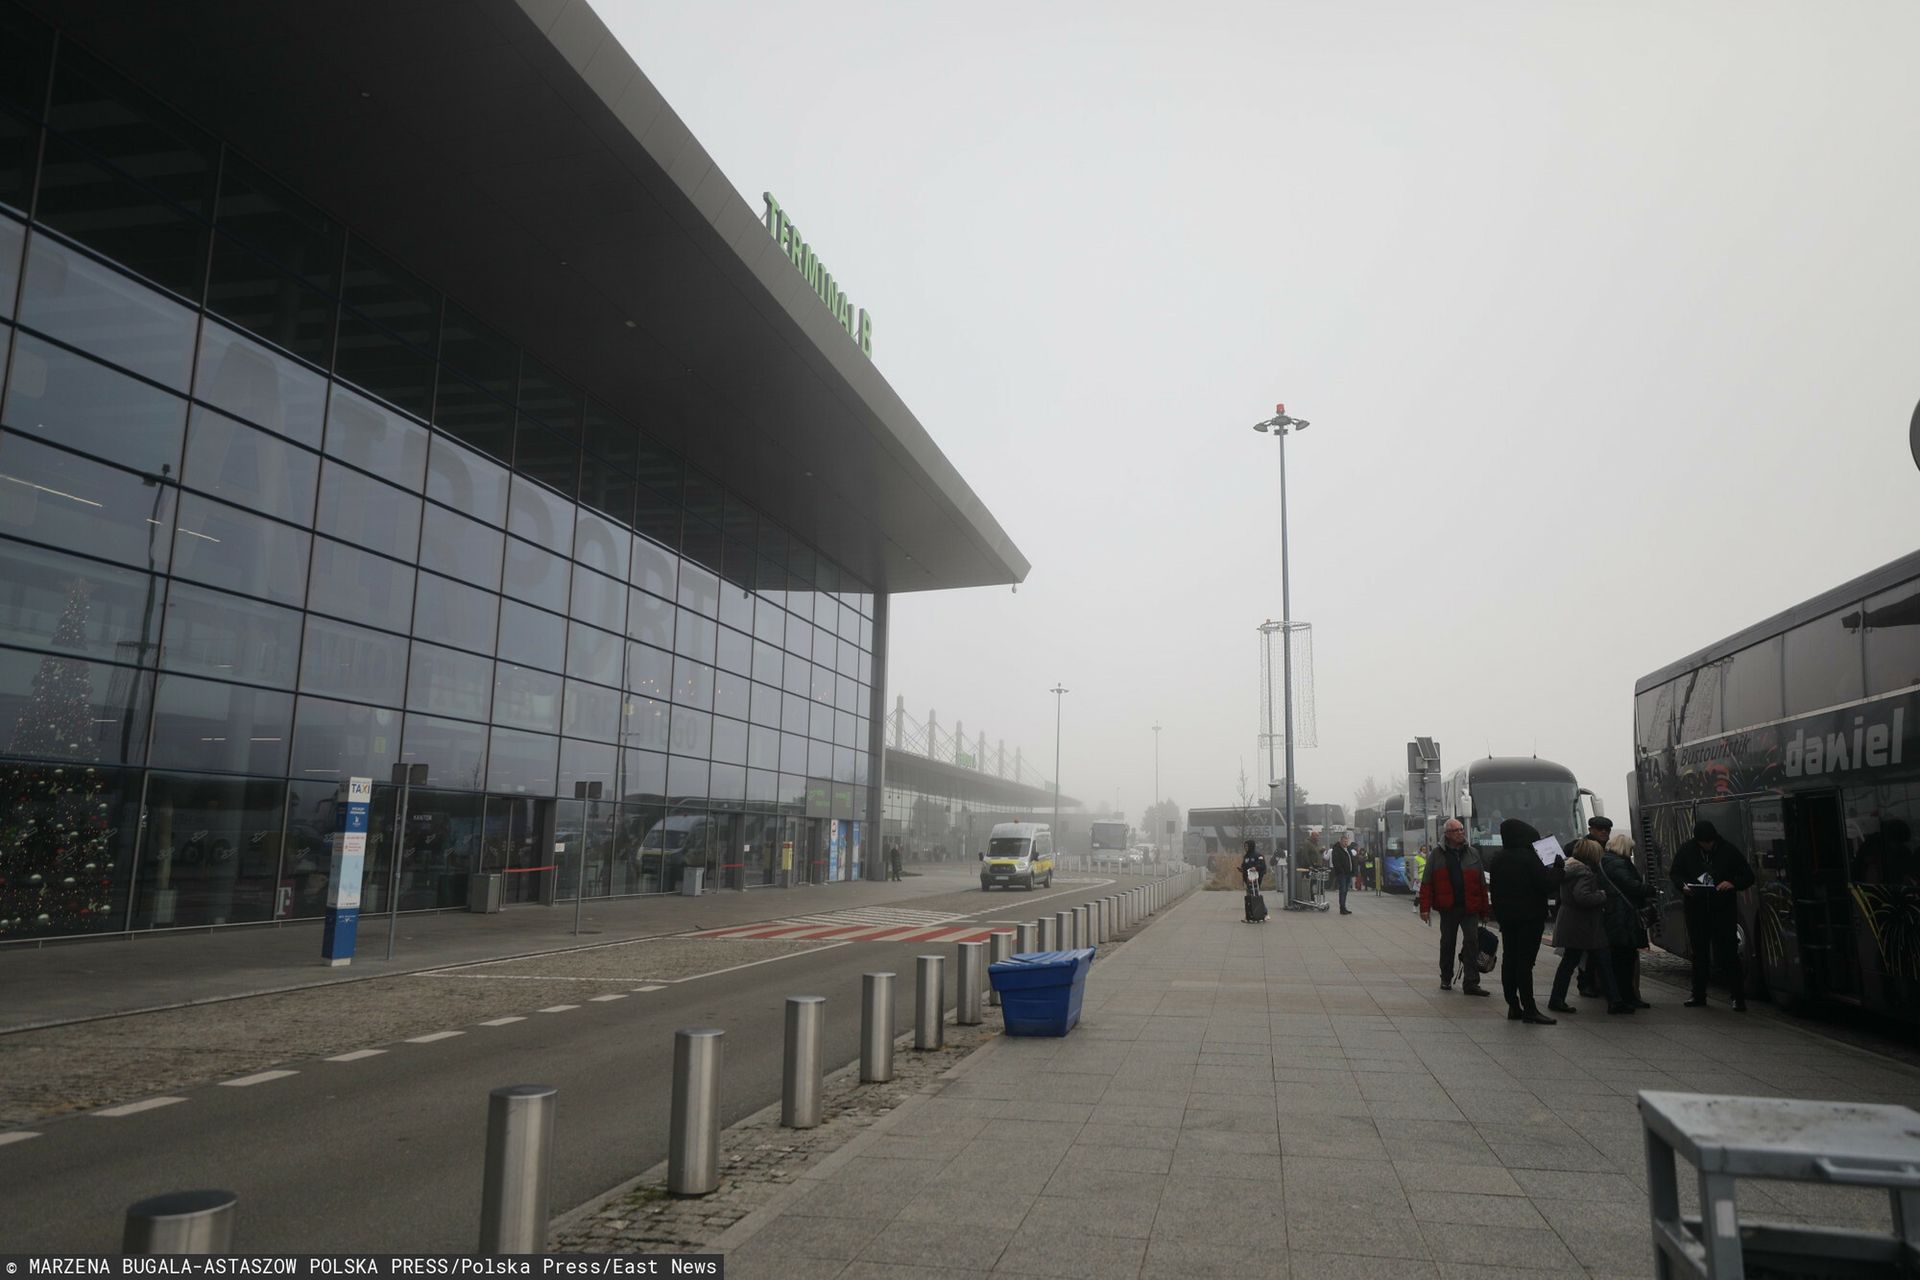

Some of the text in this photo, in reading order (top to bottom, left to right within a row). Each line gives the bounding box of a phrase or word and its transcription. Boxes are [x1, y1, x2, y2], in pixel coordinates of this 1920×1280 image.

[763, 191, 873, 362] TERMINAL B
[1681, 733, 1750, 767] Bustouristik
[1785, 706, 1905, 778] daniel
[351, 783, 370, 794] TAXI
